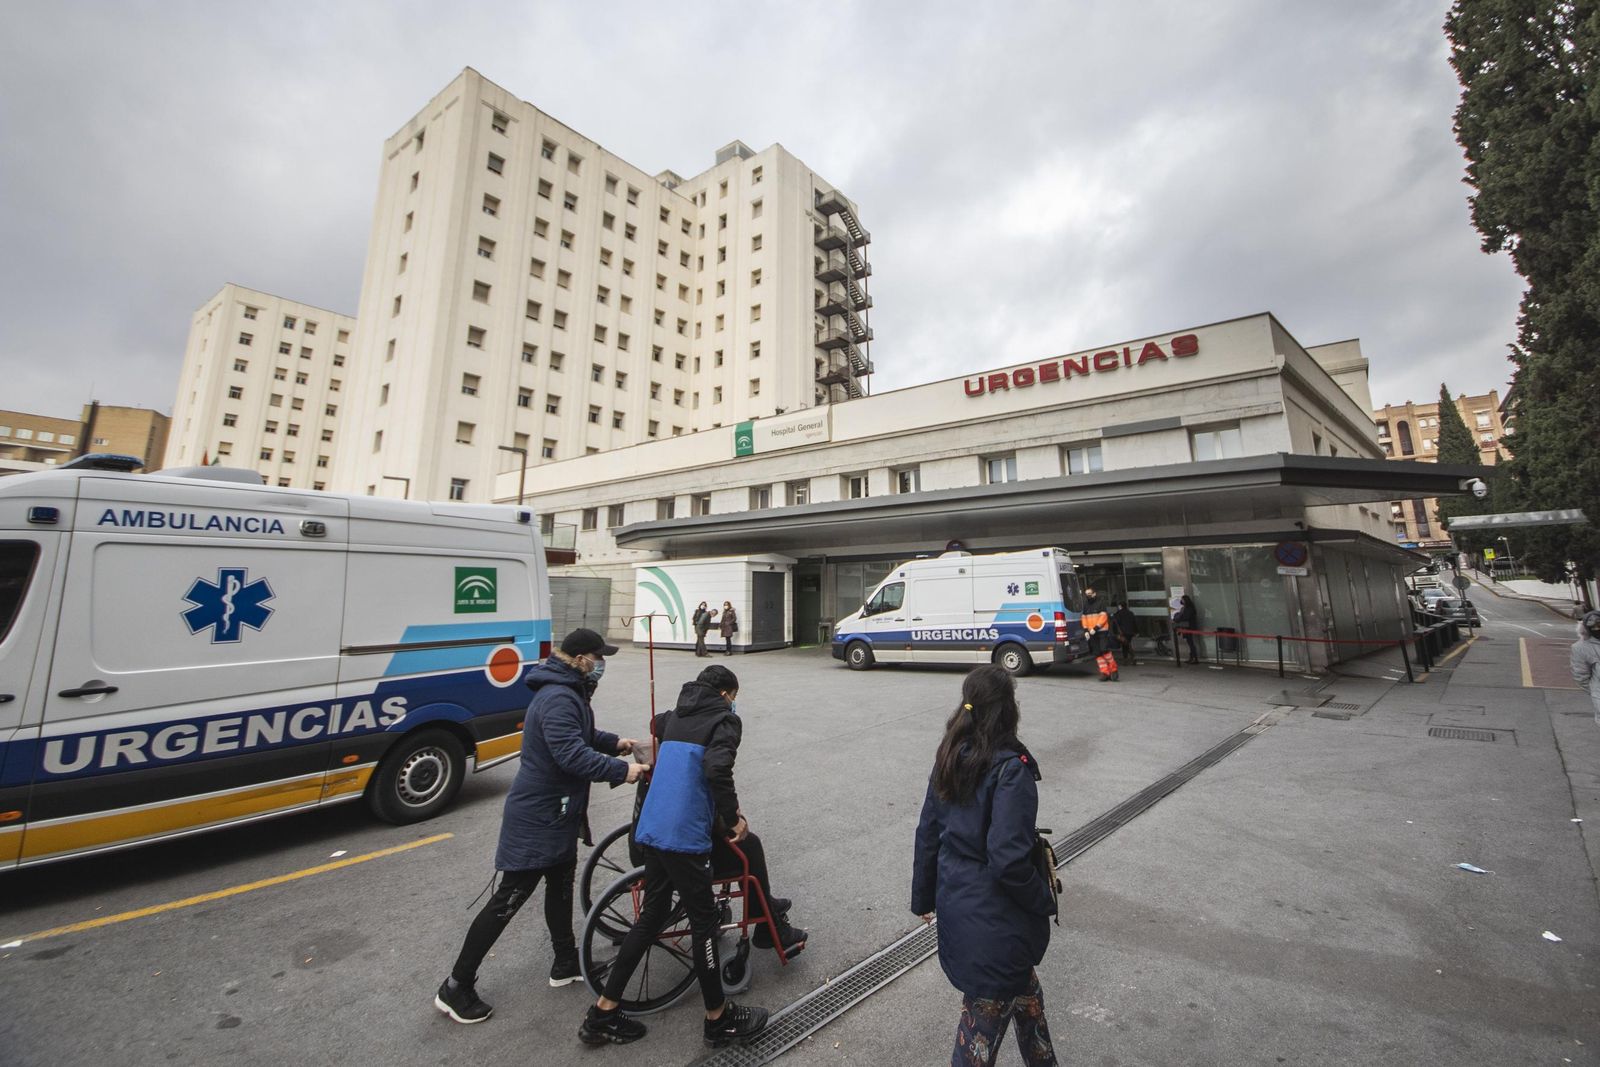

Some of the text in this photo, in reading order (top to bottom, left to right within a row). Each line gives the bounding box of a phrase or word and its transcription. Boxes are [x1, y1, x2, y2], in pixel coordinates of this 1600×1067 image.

[964, 334, 1199, 396] URGENCIAS
[771, 426, 795, 437] Hospital
[797, 420, 823, 431] General
[98, 508, 285, 535] AMBULANCIA
[911, 628, 1000, 641] URGENCIAS
[43, 696, 408, 775] URGENCIAS
